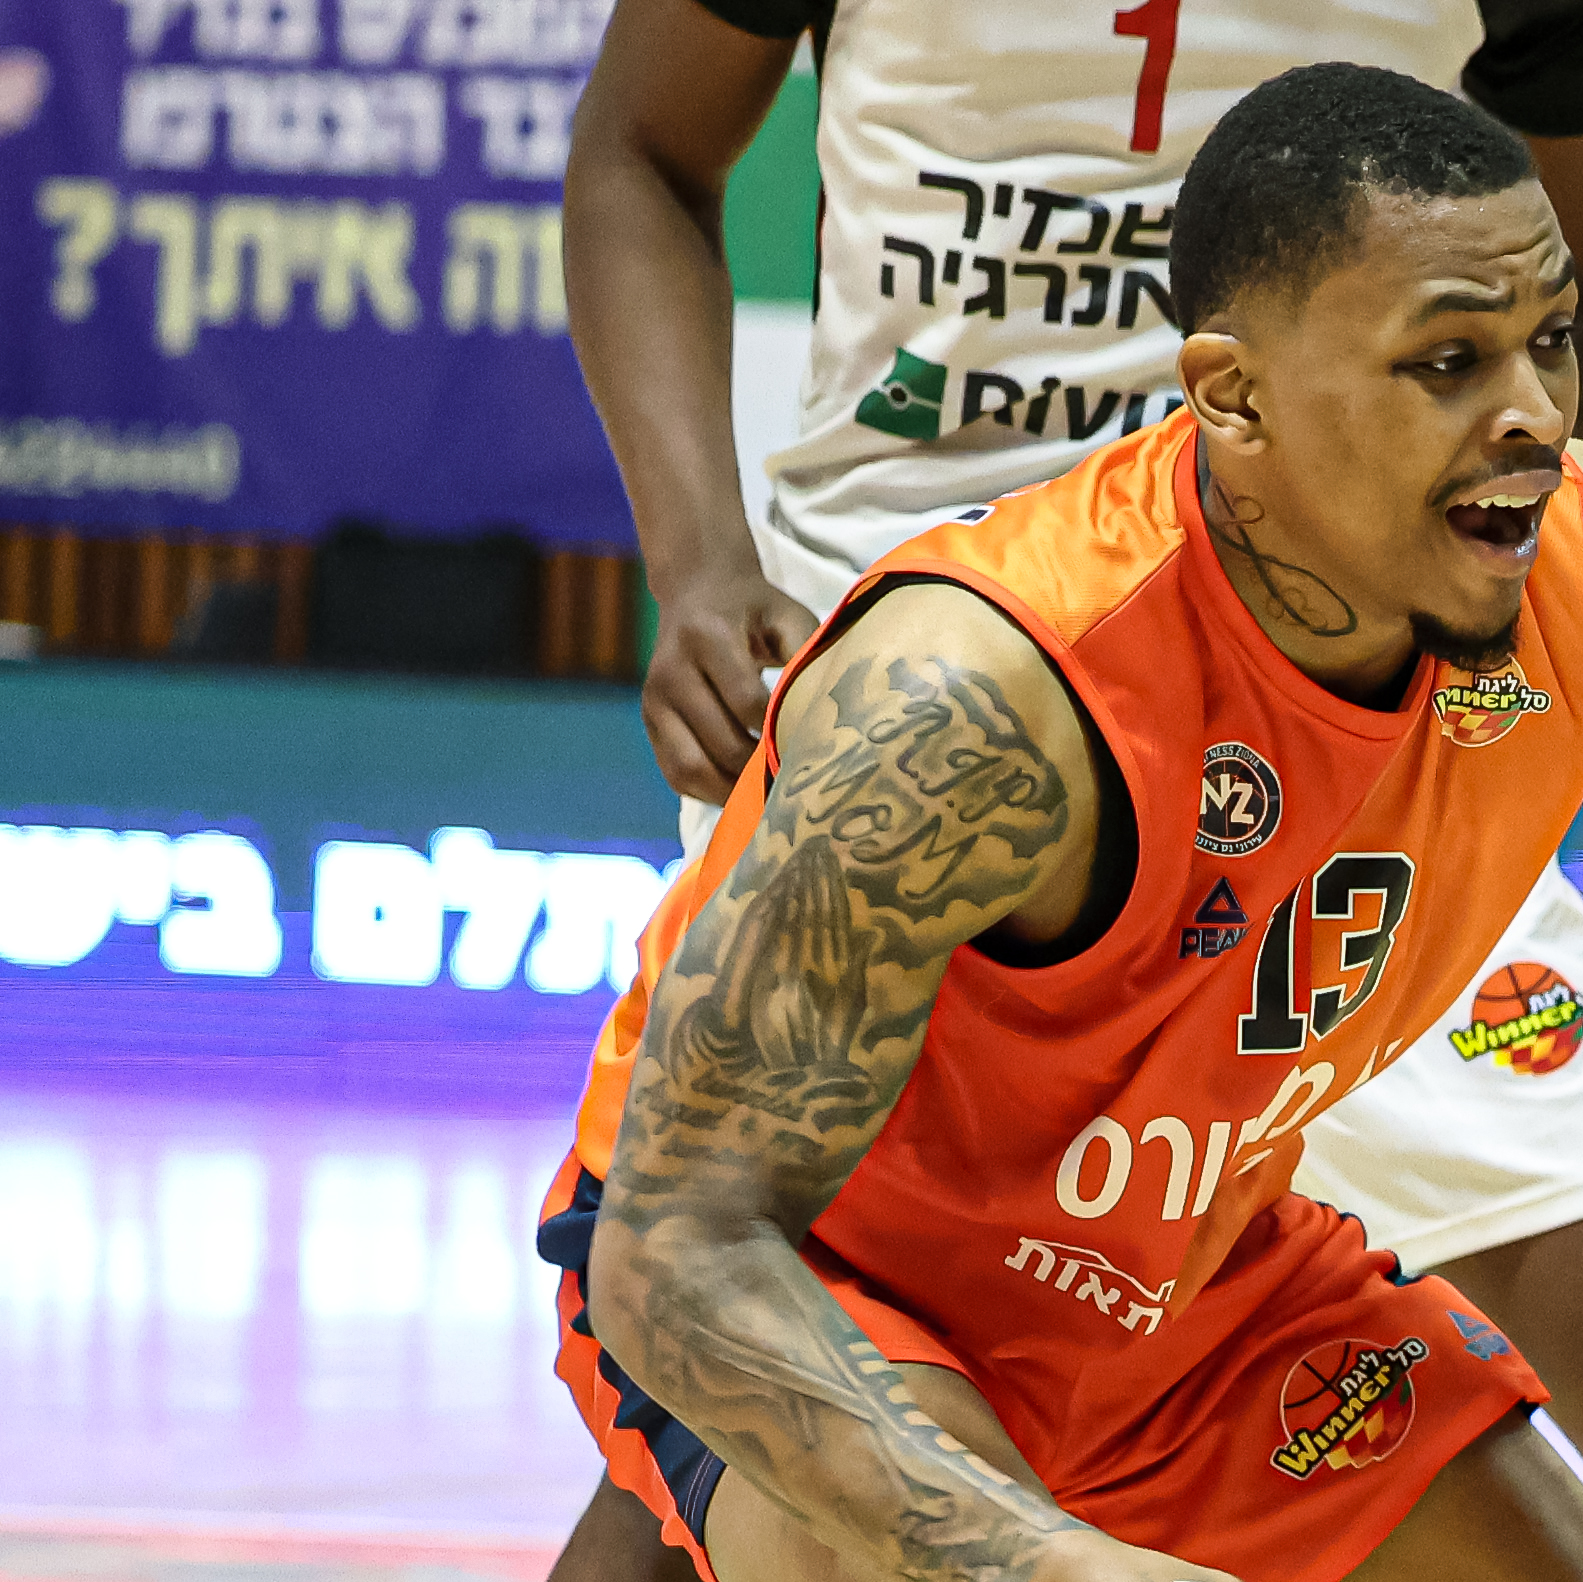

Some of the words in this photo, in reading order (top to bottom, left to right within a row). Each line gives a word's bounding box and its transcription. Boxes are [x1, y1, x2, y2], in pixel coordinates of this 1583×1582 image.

[1113, 0, 1180, 153] 1
[1237, 852, 1416, 1055] 13
[1451, 1001, 1577, 1058] Winner
[1278, 1364, 1390, 1474] Winner
